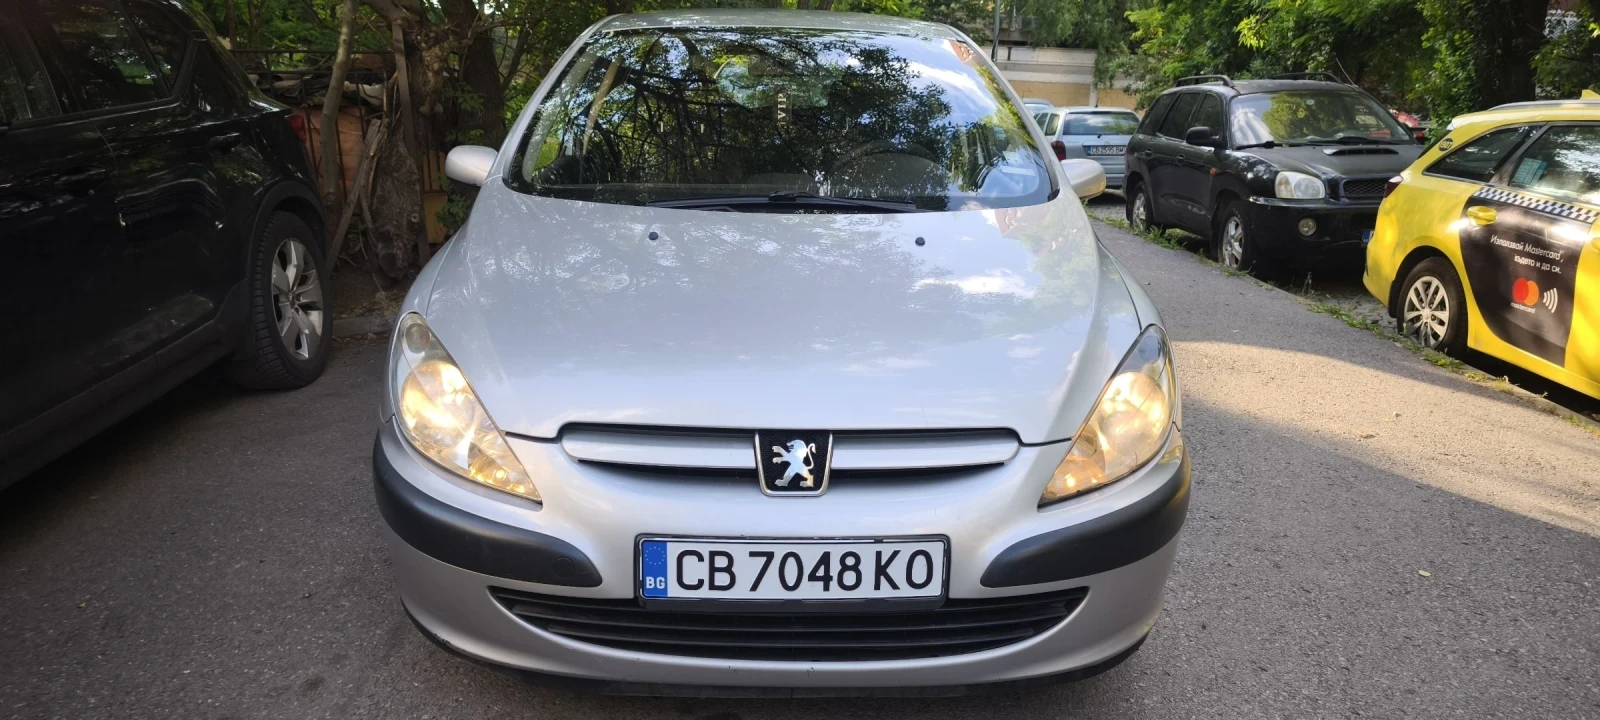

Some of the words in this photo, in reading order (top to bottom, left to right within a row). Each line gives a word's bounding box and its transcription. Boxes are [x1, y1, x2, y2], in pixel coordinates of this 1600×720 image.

[1536, 260, 1541, 268] и
[748, 550, 863, 592] 7048
[645, 577, 666, 589] BG
